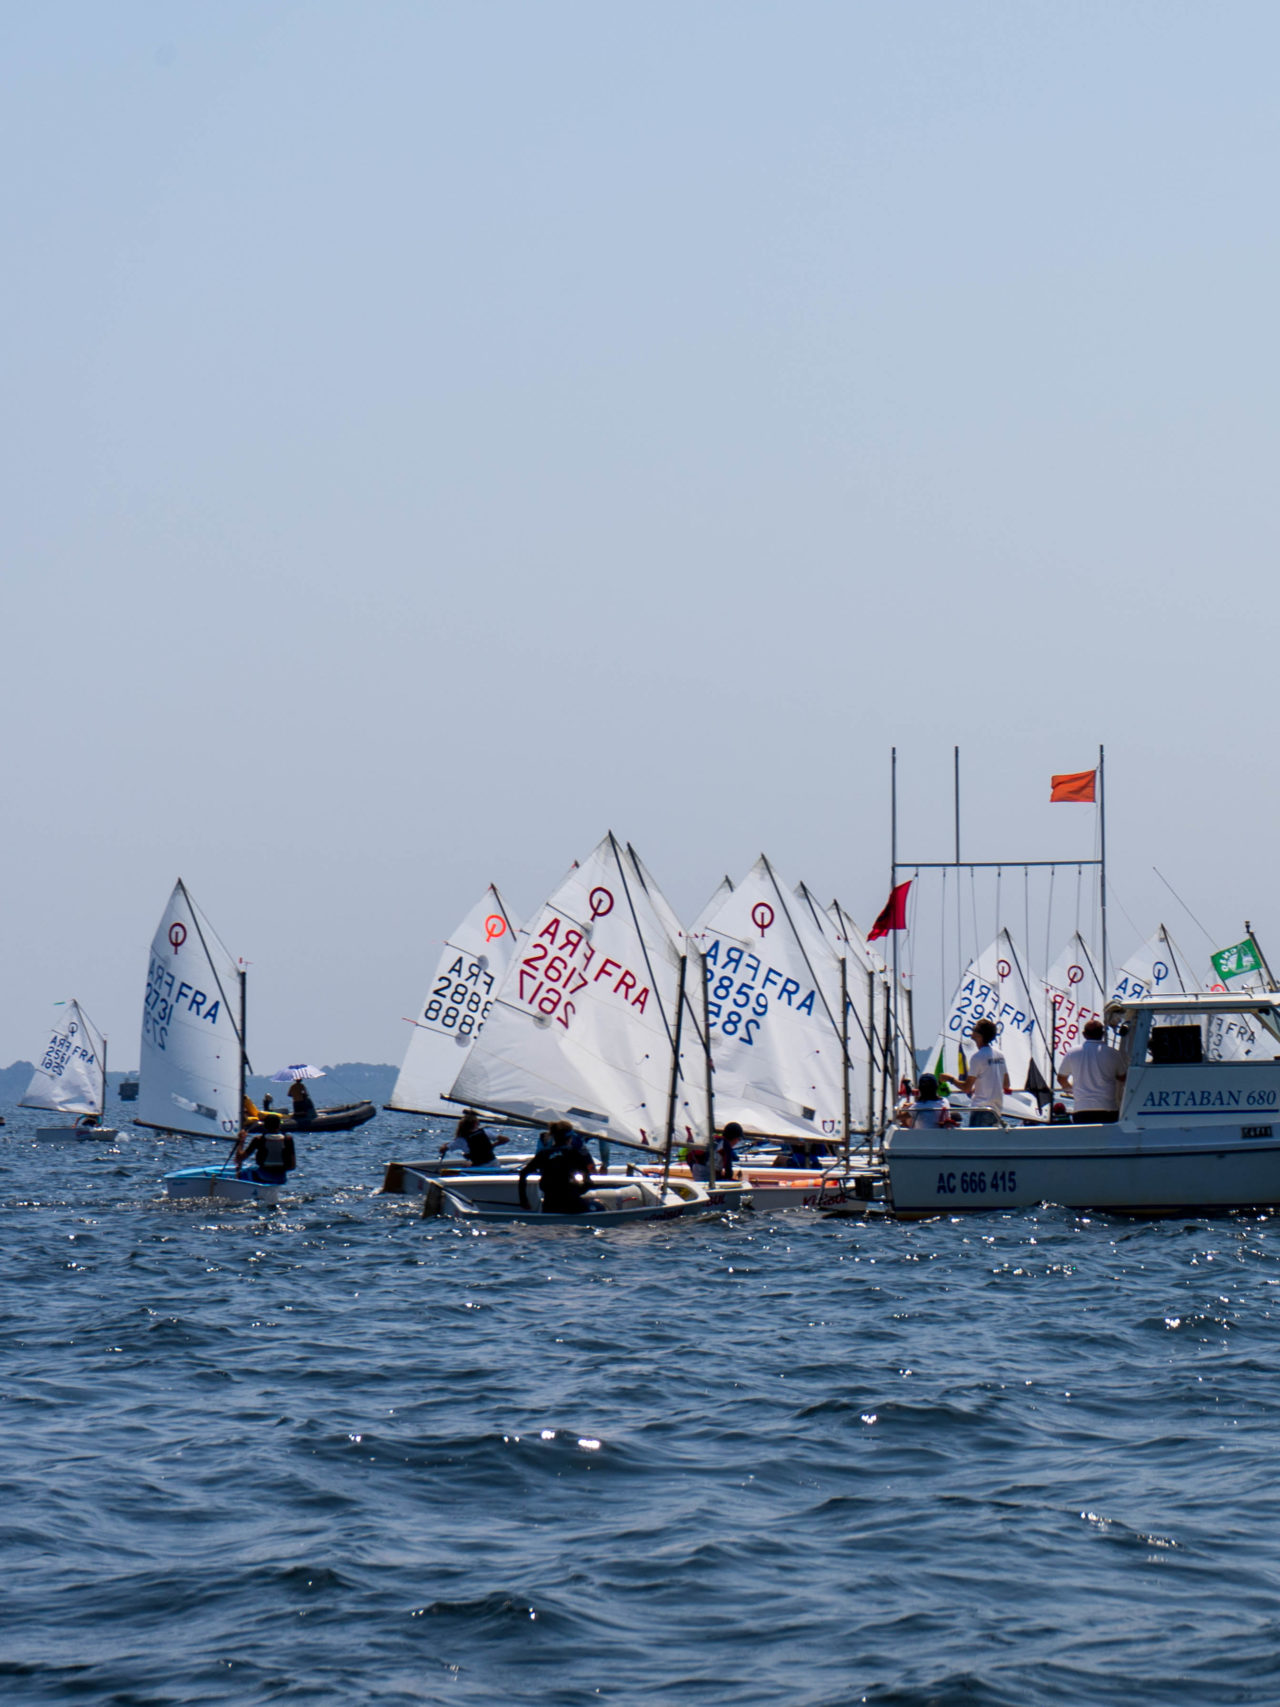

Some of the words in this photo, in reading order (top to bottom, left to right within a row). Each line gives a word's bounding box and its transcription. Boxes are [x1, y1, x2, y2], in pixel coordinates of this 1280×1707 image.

[522, 943, 588, 995] 2617
[175, 981, 220, 1024] FRA
[594, 958, 650, 1015] FRA
[761, 966, 816, 1017] FRA
[1000, 1002, 1035, 1034] FRA
[1225, 1022, 1256, 1044] FRA
[71, 1045, 95, 1065] FRA
[1143, 1090, 1242, 1107] ARTABAN
[1246, 1090, 1276, 1106] 680
[936, 1172, 957, 1194] AC
[961, 1171, 986, 1193] 666
[991, 1170, 1017, 1193] 415
